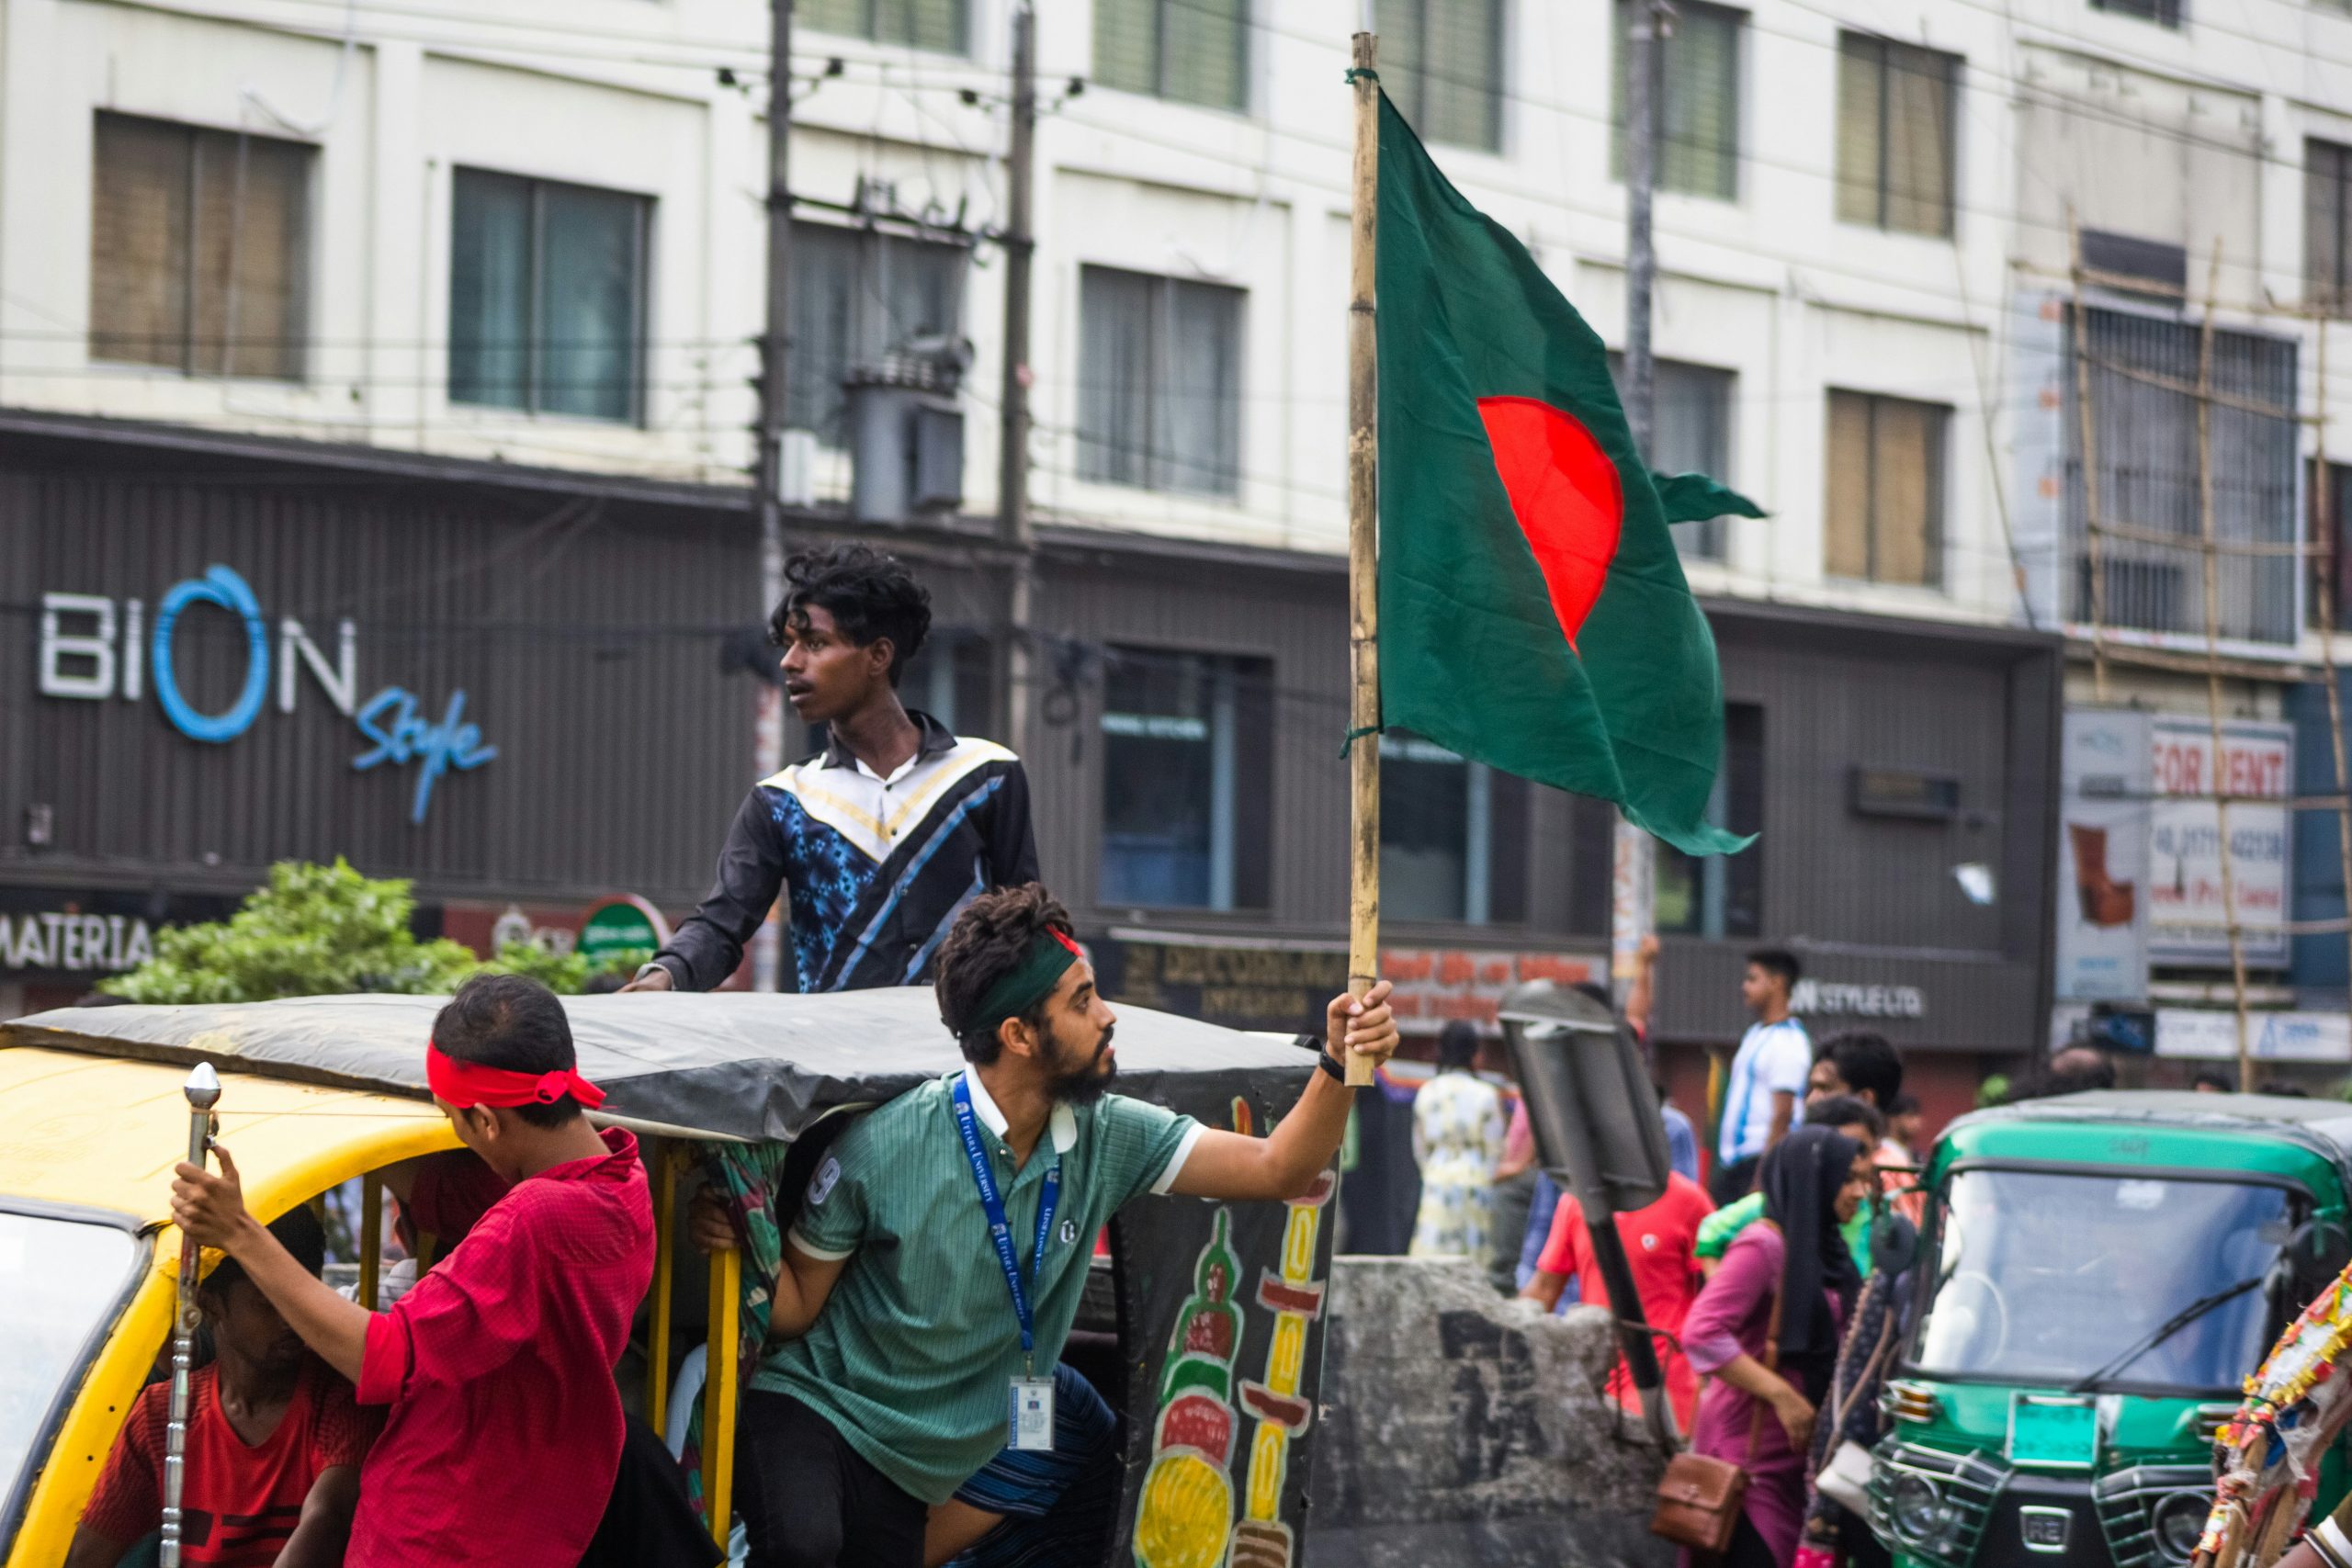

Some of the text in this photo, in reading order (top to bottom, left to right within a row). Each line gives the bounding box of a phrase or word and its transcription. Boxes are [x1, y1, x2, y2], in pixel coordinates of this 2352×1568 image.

[40, 563, 357, 744] BION
[351, 685, 499, 824] Style
[2214, 748, 2283, 799] ENT
[960, 1115, 993, 1202] UTTARA UNIVERSITY
